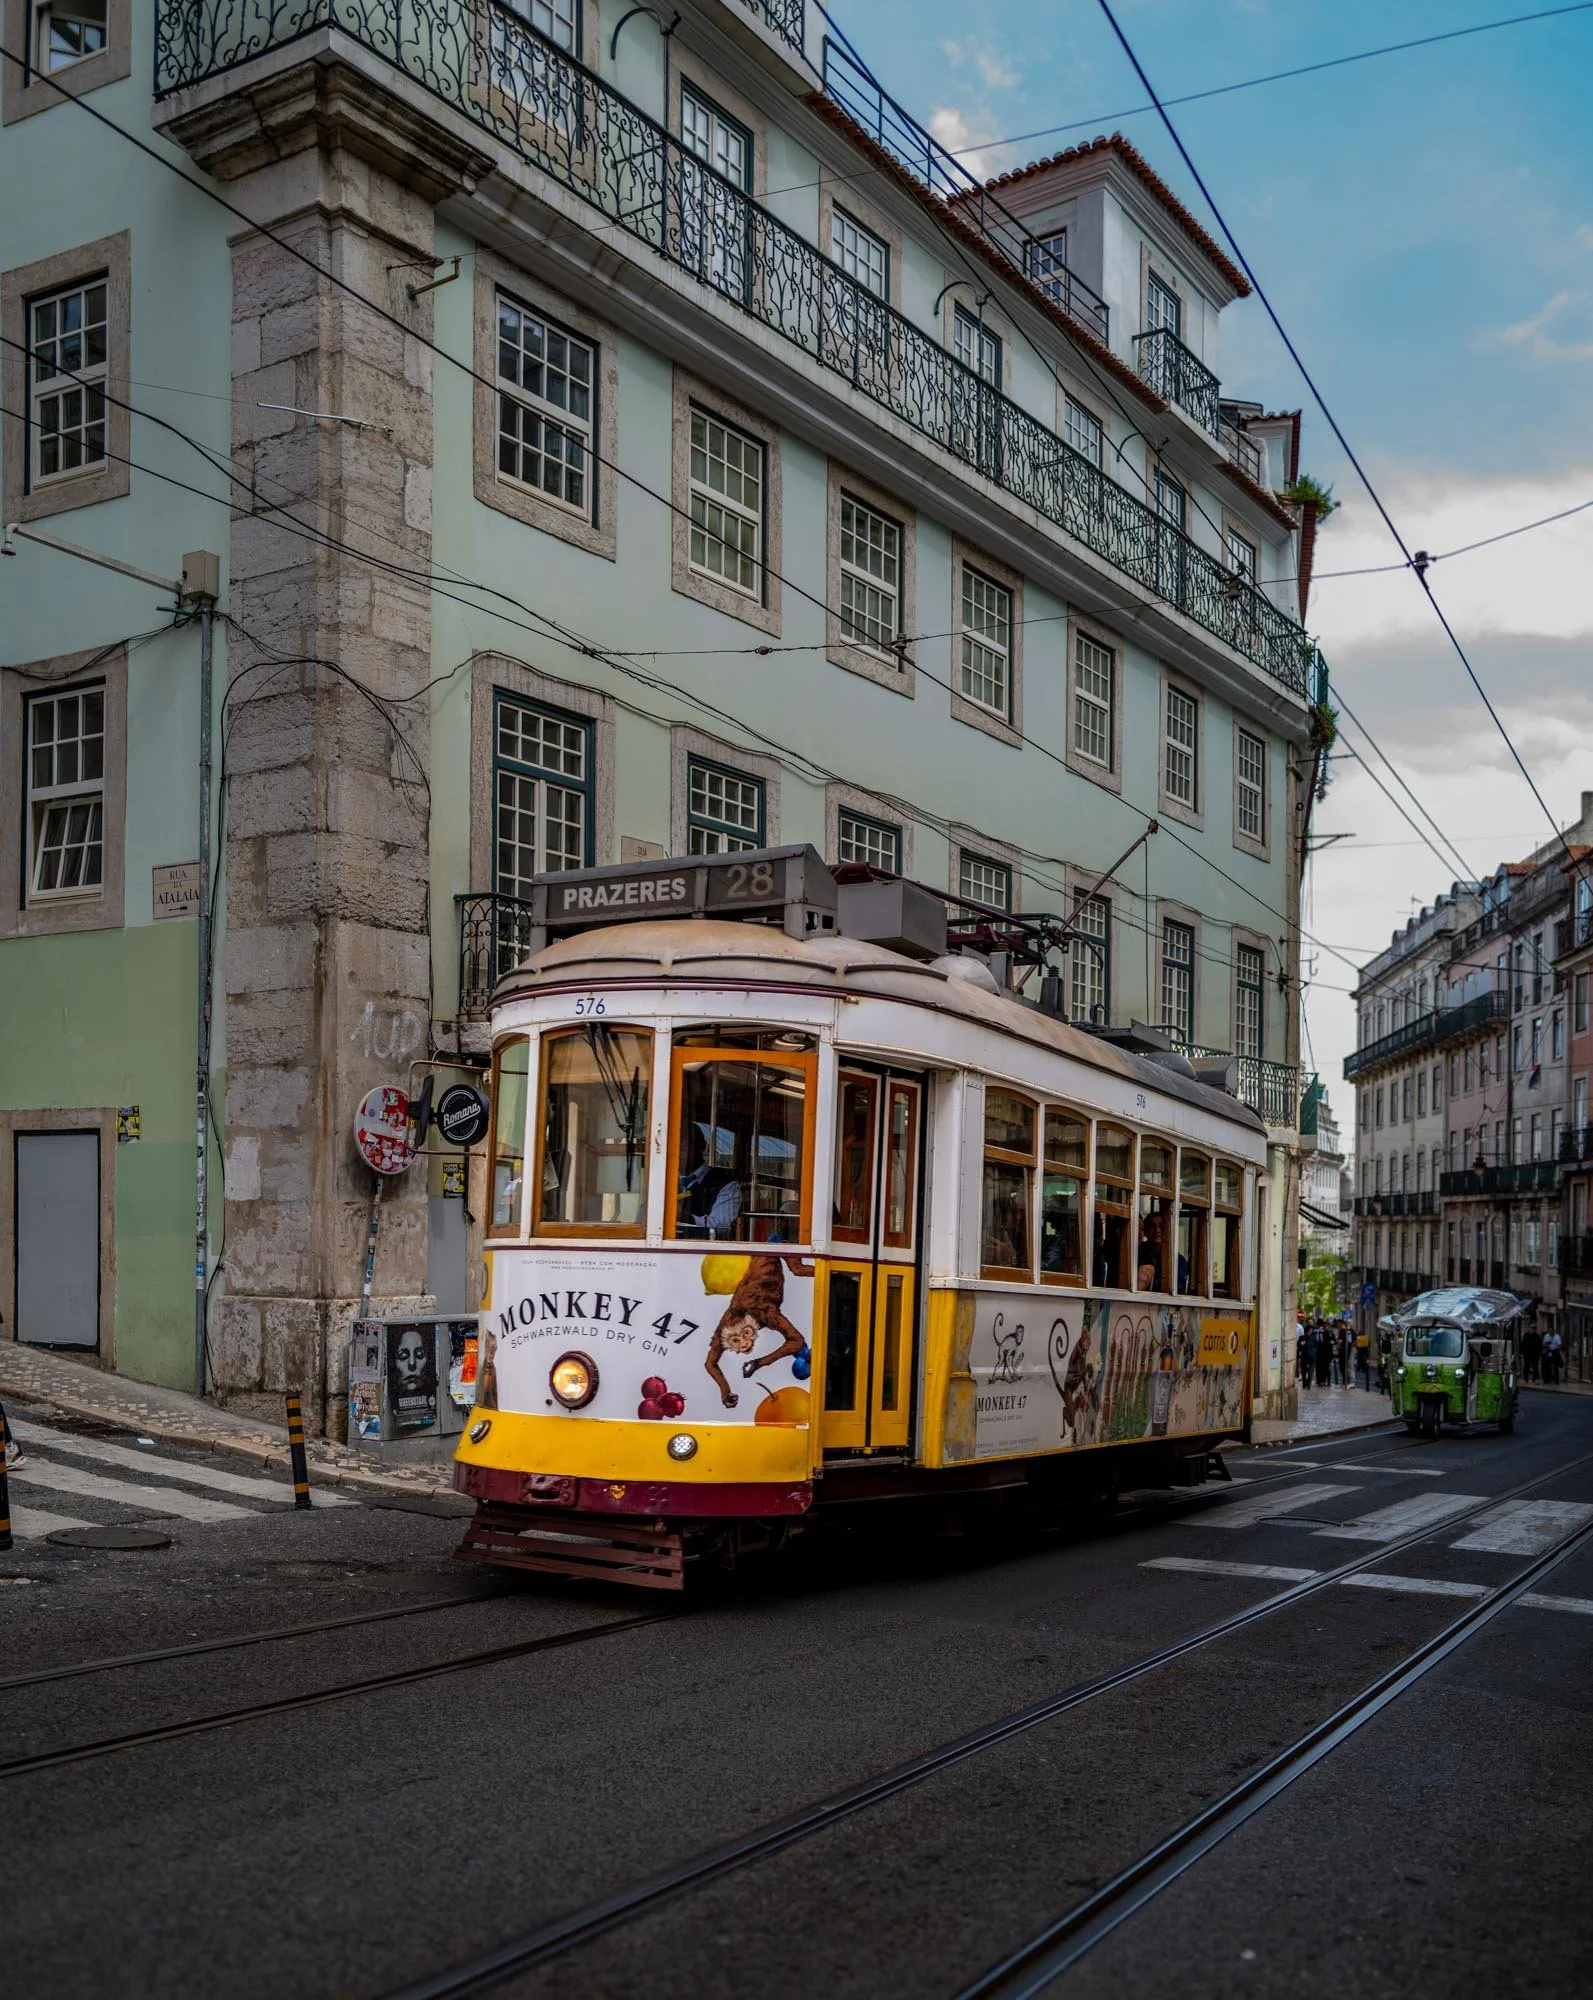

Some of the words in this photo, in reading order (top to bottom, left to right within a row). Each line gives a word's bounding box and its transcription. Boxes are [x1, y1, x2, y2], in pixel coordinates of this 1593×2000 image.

[169, 869, 187, 881] RUA
[563, 877, 687, 910] PRAZERES
[726, 862, 775, 899] 28
[158, 888, 200, 905] ATALAIA
[575, 997, 606, 1015] 576
[1136, 1093, 1147, 1109] 576
[443, 1103, 481, 1128] Romana
[499, 1290, 643, 1340] MONKEY
[651, 1312, 700, 1345] 47
[511, 1325, 599, 1349] SCHWARZWALD
[606, 1329, 636, 1344] DRY
[642, 1340, 669, 1357] GIN
[1203, 1329, 1226, 1351] carris
[976, 1395, 1017, 1412] MONKEY
[1017, 1395, 1028, 1409] 47
